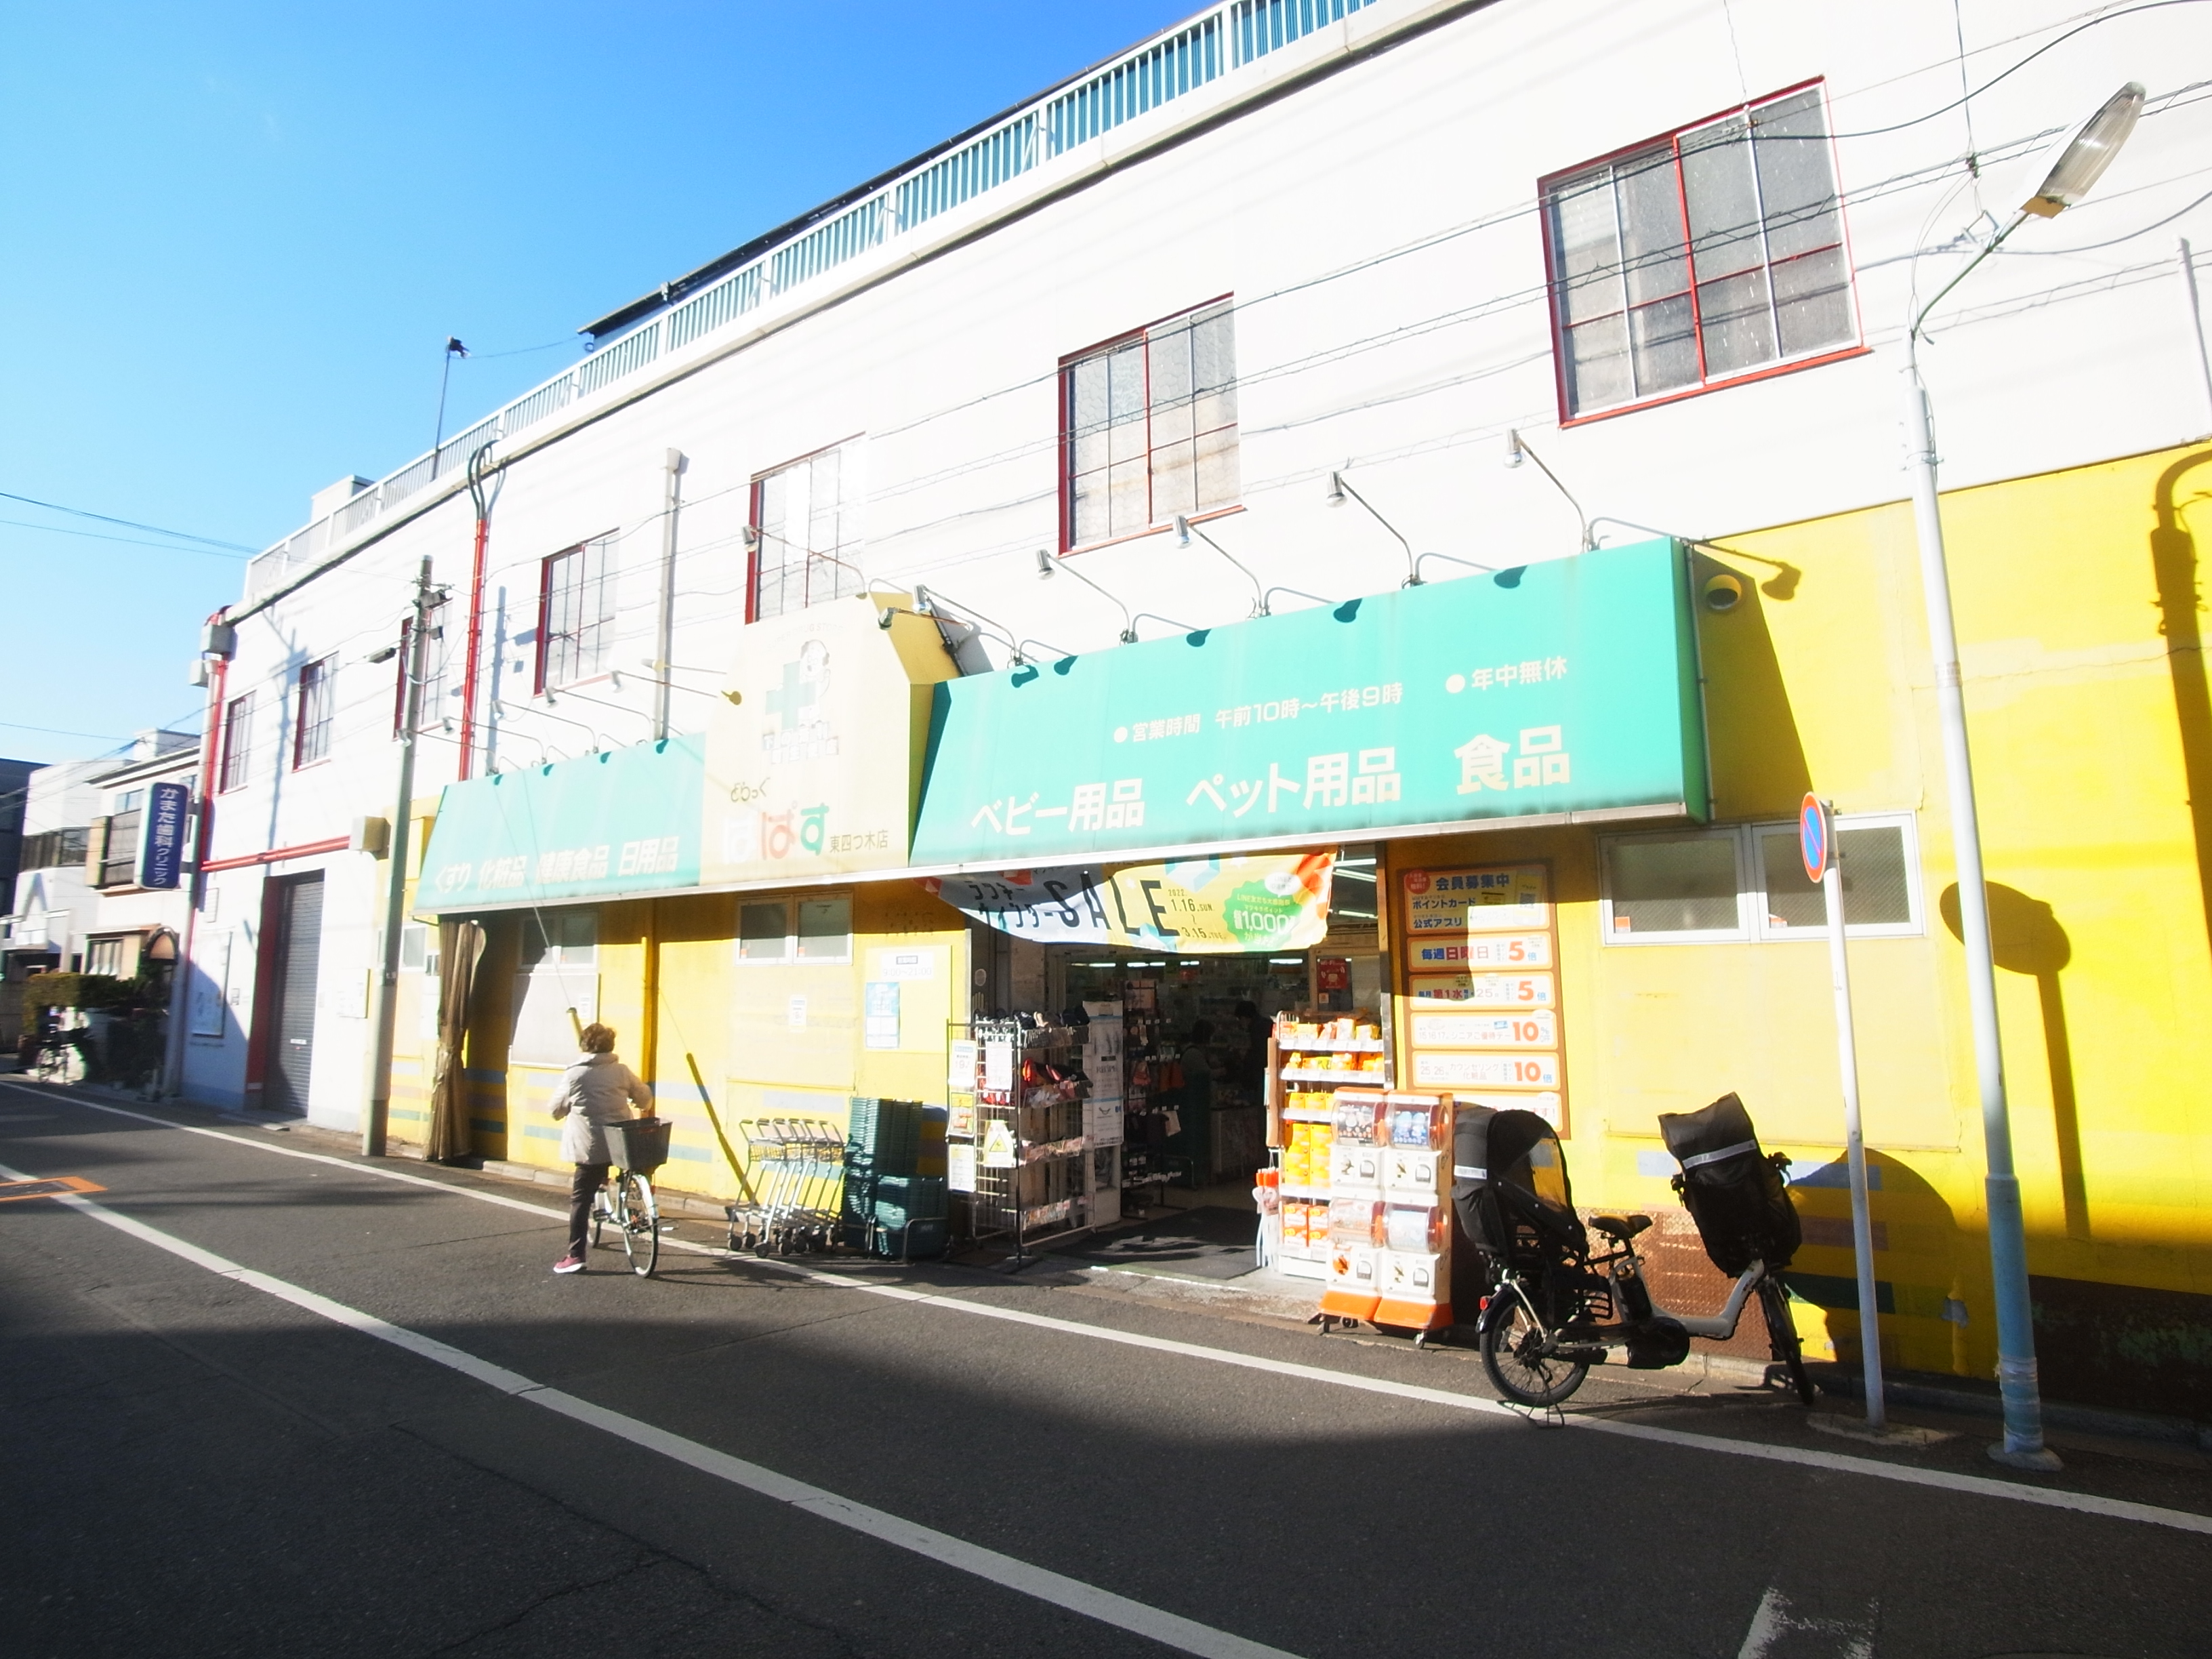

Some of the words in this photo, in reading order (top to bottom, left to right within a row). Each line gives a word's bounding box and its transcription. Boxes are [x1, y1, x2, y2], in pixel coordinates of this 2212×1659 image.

[1471, 655, 1568, 694] 年中無休
[1132, 712, 1201, 744] 営業時間
[970, 777, 1144, 838] ベビー用品
[1185, 747, 1401, 815] ペット用品
[1453, 724, 1571, 796] 食品
[154, 787, 179, 884] かまた歯科クリニック
[830, 829, 888, 855] 東四つ木店
[434, 861, 472, 895] くすり
[477, 855, 527, 892] 化粧品
[535, 844, 611, 885] 健康食品
[618, 836, 679, 877] 日用品
[1435, 873, 1511, 891] 会員募集中
[1043, 870, 1181, 938] SALE
[1412, 897, 1477, 910] ポイントカード
[1413, 917, 1462, 929] 公式アプリ
[1421, 946, 1490, 960] 毎週日曜日
[1450, 1063, 1500, 1071] カウンセリング
[1463, 1071, 1488, 1081] 化粧品
